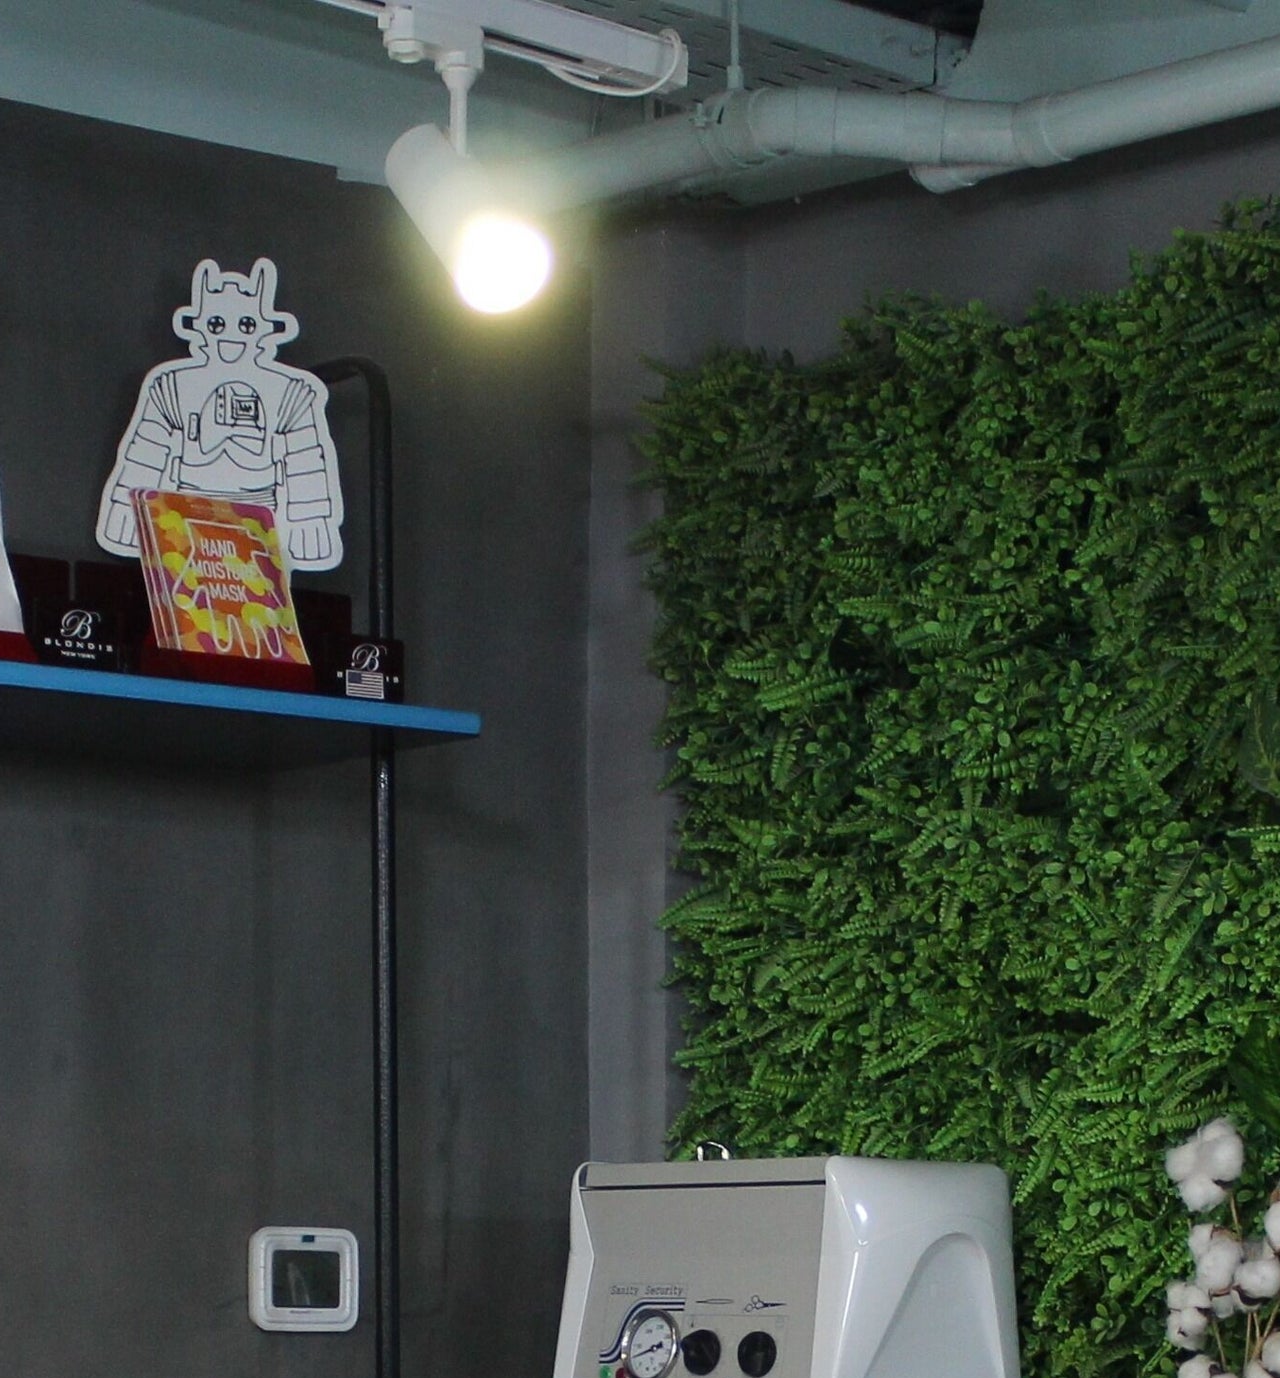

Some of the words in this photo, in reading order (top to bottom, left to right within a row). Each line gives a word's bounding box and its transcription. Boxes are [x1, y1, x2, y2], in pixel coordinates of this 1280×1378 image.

[200, 537, 237, 557] HAND
[209, 585, 248, 604] MASK
[644, 1286, 684, 1297] Security
